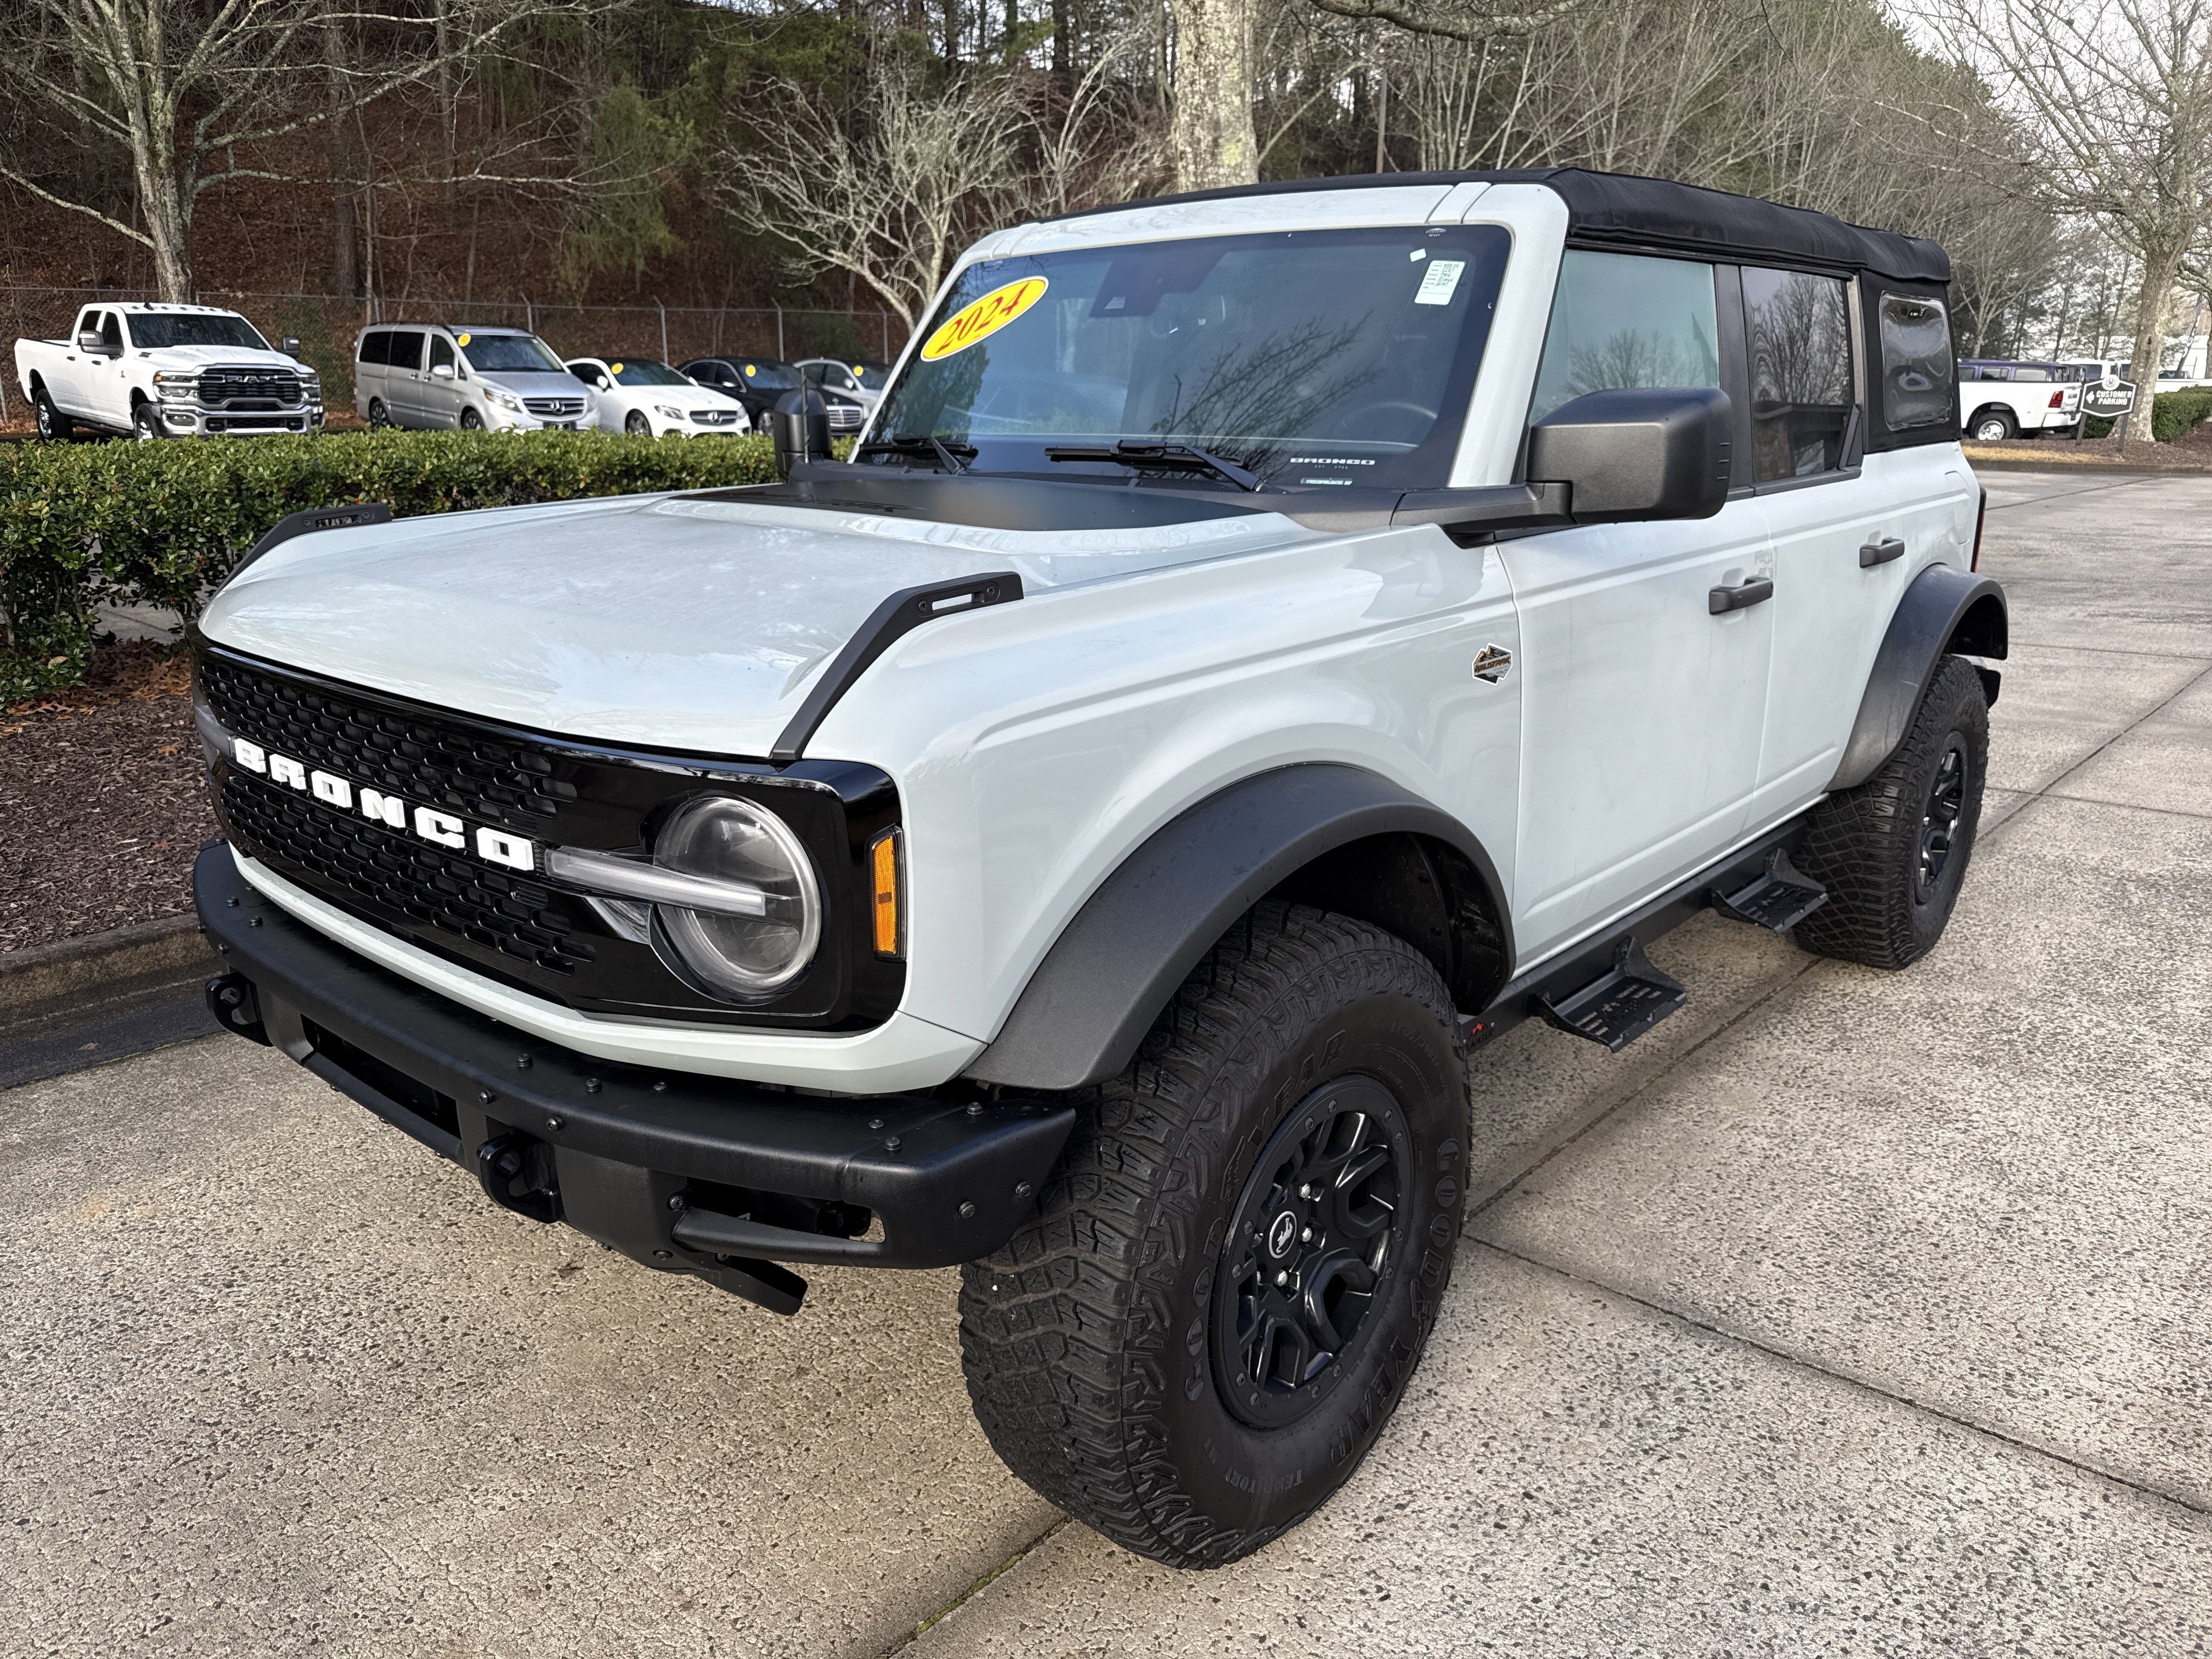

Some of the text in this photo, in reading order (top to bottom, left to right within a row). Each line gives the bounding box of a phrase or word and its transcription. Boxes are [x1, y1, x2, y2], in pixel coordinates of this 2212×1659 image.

[935, 282, 1031, 355] 2024
[226, 375, 276, 383] RAM
[2096, 390, 2132, 398] CUSTOMER
[2098, 397, 2128, 405] PARKING
[234, 737, 534, 871] BRONCO
